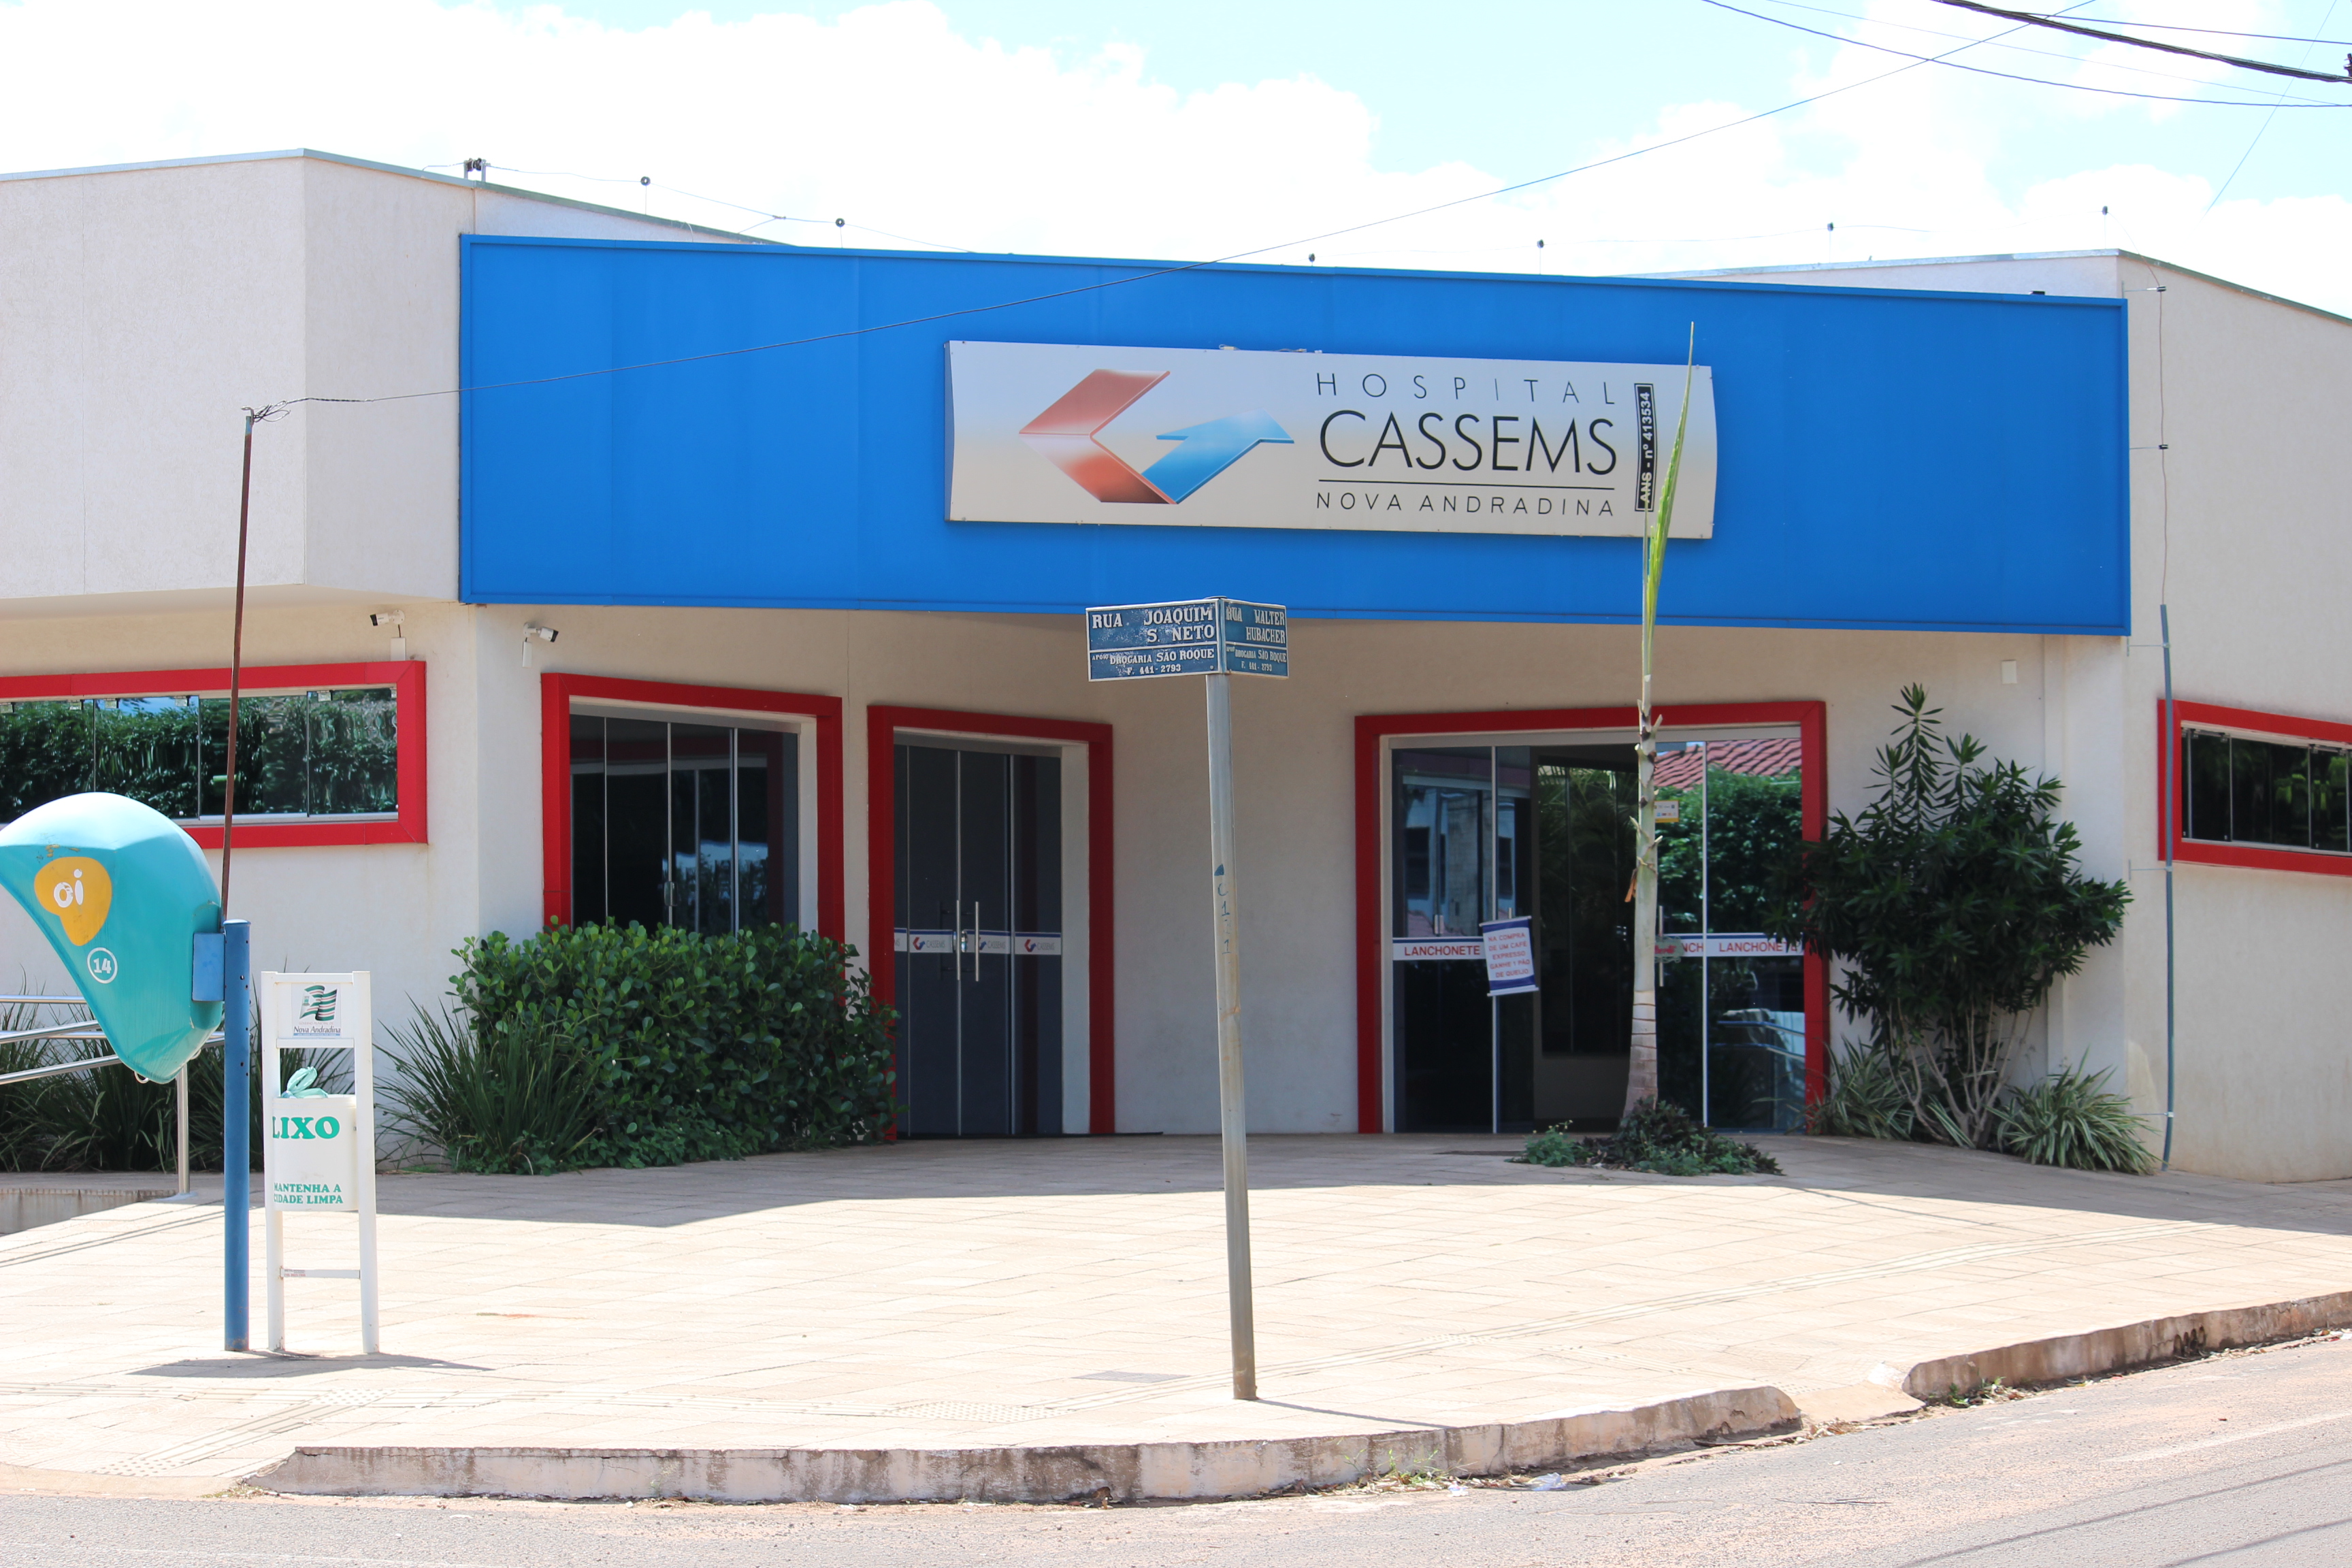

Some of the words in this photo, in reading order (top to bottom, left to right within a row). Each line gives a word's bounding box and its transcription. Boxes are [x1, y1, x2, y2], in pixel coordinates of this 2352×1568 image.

[1317, 372, 1615, 405] HOSPITAL
[1639, 392, 1652, 441] 413534
[1320, 410, 1617, 475] CASSEMS
[1640, 472, 1651, 503] ANS
[1317, 491, 1402, 511] NOVA
[1419, 494, 1614, 517] ANDRADINA
[1092, 613, 1122, 629] RUA
[1143, 606, 1213, 625] JOAQUIM
[1226, 606, 1243, 622] RUA
[1254, 609, 1286, 625] WALTER
[1147, 628, 1160, 642] S.
[1172, 624, 1215, 642] NETO
[1245, 627, 1286, 644] HUBACHER
[1110, 655, 1152, 665] DROGARIA
[1156, 649, 1177, 662] SÃO
[1179, 649, 1215, 661] ROQUE
[1235, 649, 1256, 659] DROGARIA
[1270, 651, 1287, 664] ROQUE
[1499, 932, 1526, 941] COMPRA
[1404, 945, 1480, 956] LANCHONETE
[1492, 951, 1526, 960] EXPRESSO
[93, 958, 112, 974] 14
[310, 1025, 341, 1033] Andradina
[333, 1183, 342, 1192] A
[306, 1195, 343, 1204] LIMPA
